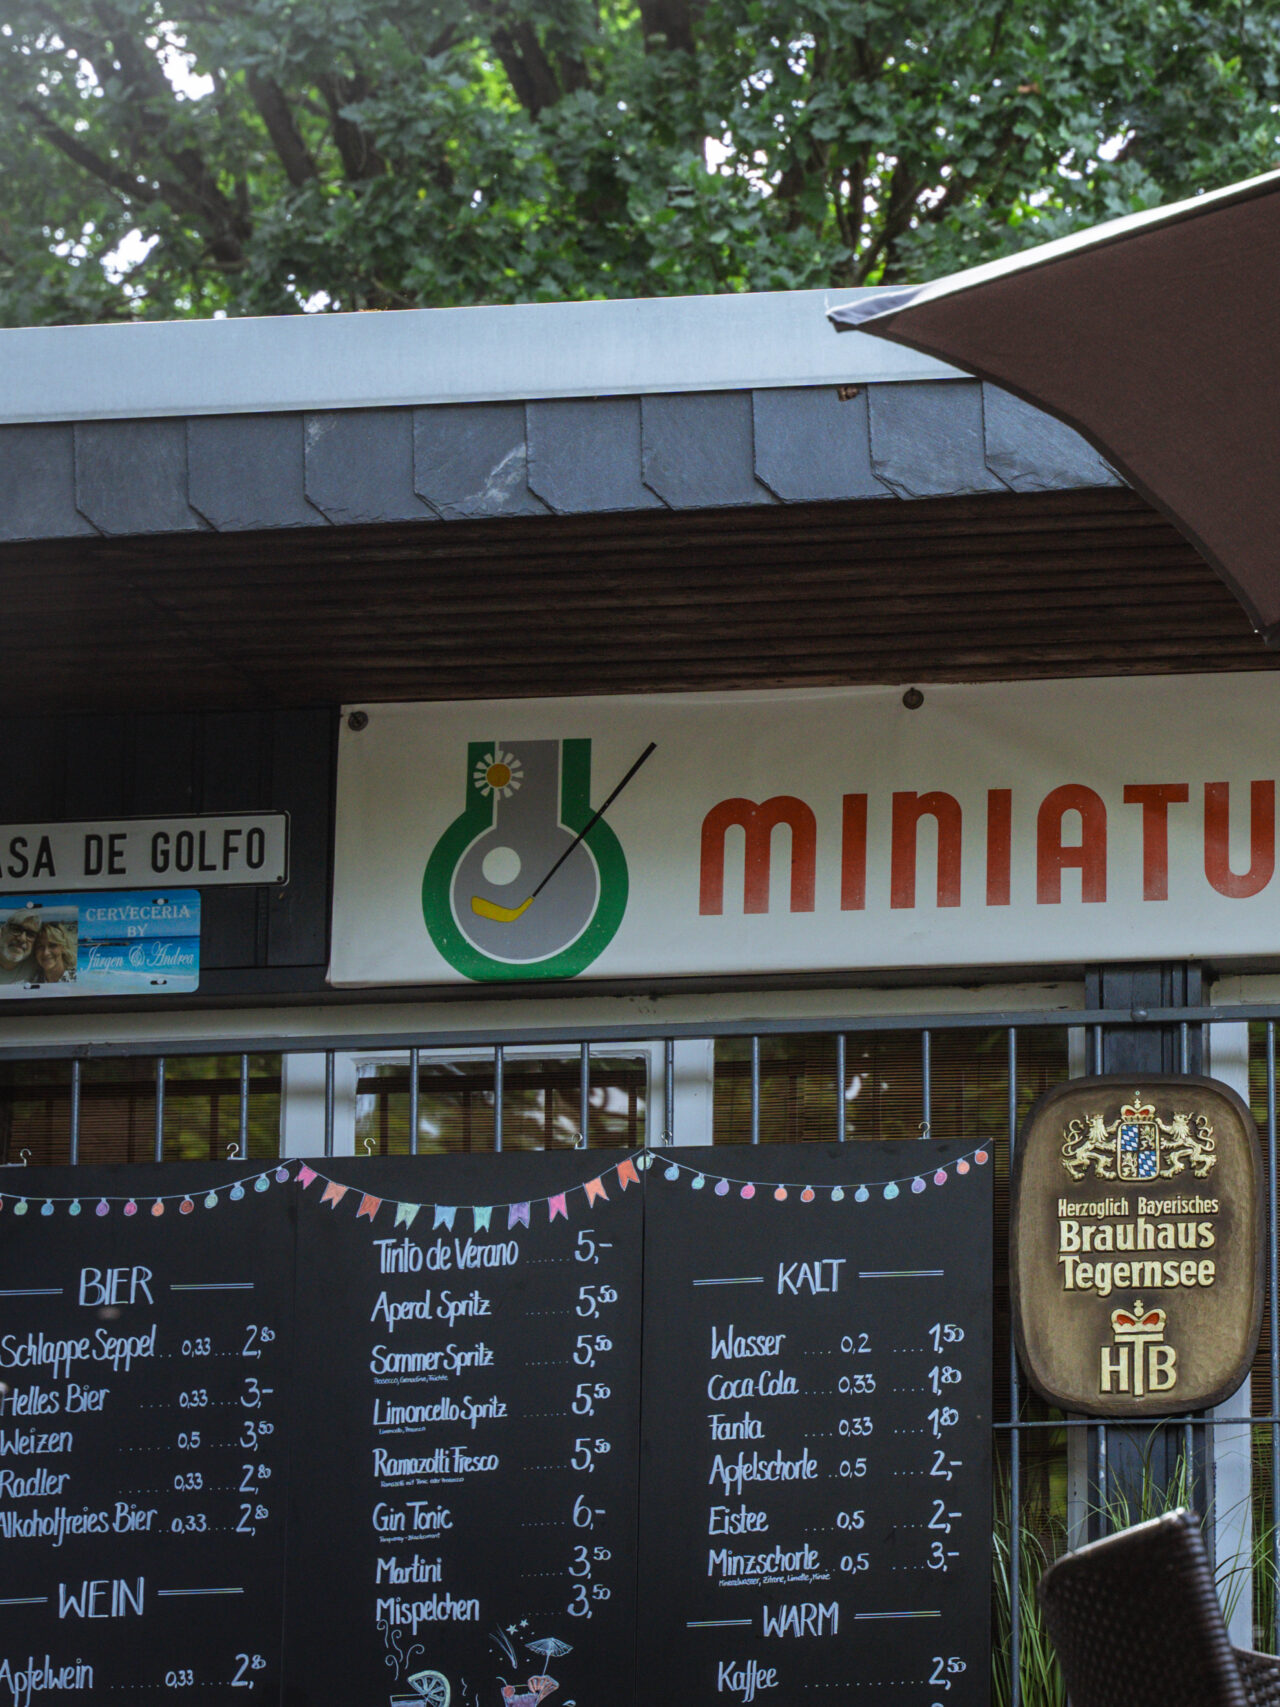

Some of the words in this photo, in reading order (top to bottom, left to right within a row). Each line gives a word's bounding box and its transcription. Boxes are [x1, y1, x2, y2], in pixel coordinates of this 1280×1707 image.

[0, 836, 56, 878] SA
[84, 833, 127, 876] DE
[151, 827, 265, 873] GOLFO
[86, 905, 191, 921] CERVECERIA
[127, 923, 148, 937] BY
[146, 941, 194, 967] Andrea
[1057, 1198, 1129, 1220] Herzoglich
[1137, 1195, 1219, 1217] Bayerisches
[1058, 1217, 1216, 1253] Brauhaus
[373, 1237, 423, 1274] Tinto
[426, 1238, 452, 1271] de
[454, 1237, 519, 1270] Verano
[79, 1266, 154, 1306] BIER
[777, 1259, 847, 1295] KALT
[1058, 1254, 1217, 1298] Tegernsee
[370, 1290, 433, 1333] Aperol
[436, 1290, 492, 1327] Spritz
[0, 1333, 90, 1379] Schlappe
[92, 1324, 157, 1372] Seppel
[181, 1337, 211, 1358] 0,33
[370, 1345, 444, 1374] Sommer
[443, 1342, 495, 1376] Spritz
[711, 1324, 786, 1360] Wasser
[840, 1333, 872, 1355] 0,2
[0, 1385, 60, 1416] Helles
[65, 1383, 110, 1413] Bier
[179, 1389, 208, 1408] 0,33
[707, 1369, 799, 1401] Coca-Cola
[838, 1373, 876, 1396] 0,33
[373, 1397, 460, 1425] Limoncello
[460, 1395, 508, 1430] Spritz
[707, 1411, 765, 1441] Fanta
[838, 1416, 874, 1438] 0,33
[0, 1427, 73, 1456] Weizen
[178, 1432, 201, 1452] 0,5
[372, 1448, 450, 1477] Ramazotti
[450, 1446, 500, 1473] Fresco
[708, 1447, 818, 1496] Apfelschorle
[839, 1458, 867, 1479] 0,5
[0, 1468, 70, 1498] Radler
[174, 1473, 204, 1493] 0,33
[0, 1506, 110, 1548] Alkoholfreies
[112, 1502, 158, 1533] Bier
[171, 1513, 208, 1535] 0,33
[372, 1502, 405, 1532] Gin
[406, 1501, 454, 1530] Tonic
[708, 1504, 769, 1535] Eistee
[836, 1510, 865, 1531] 0,5
[375, 1554, 443, 1584] Martini
[708, 1543, 820, 1577] Minzschorle
[840, 1553, 870, 1575] 0,5
[58, 1576, 145, 1619] WEIN
[376, 1592, 480, 1636] Mispelchen
[763, 1601, 839, 1638] WARM
[0, 1654, 94, 1707] Apfelwein
[165, 1669, 194, 1689] 0,33
[718, 1659, 779, 1703] Kaffee
